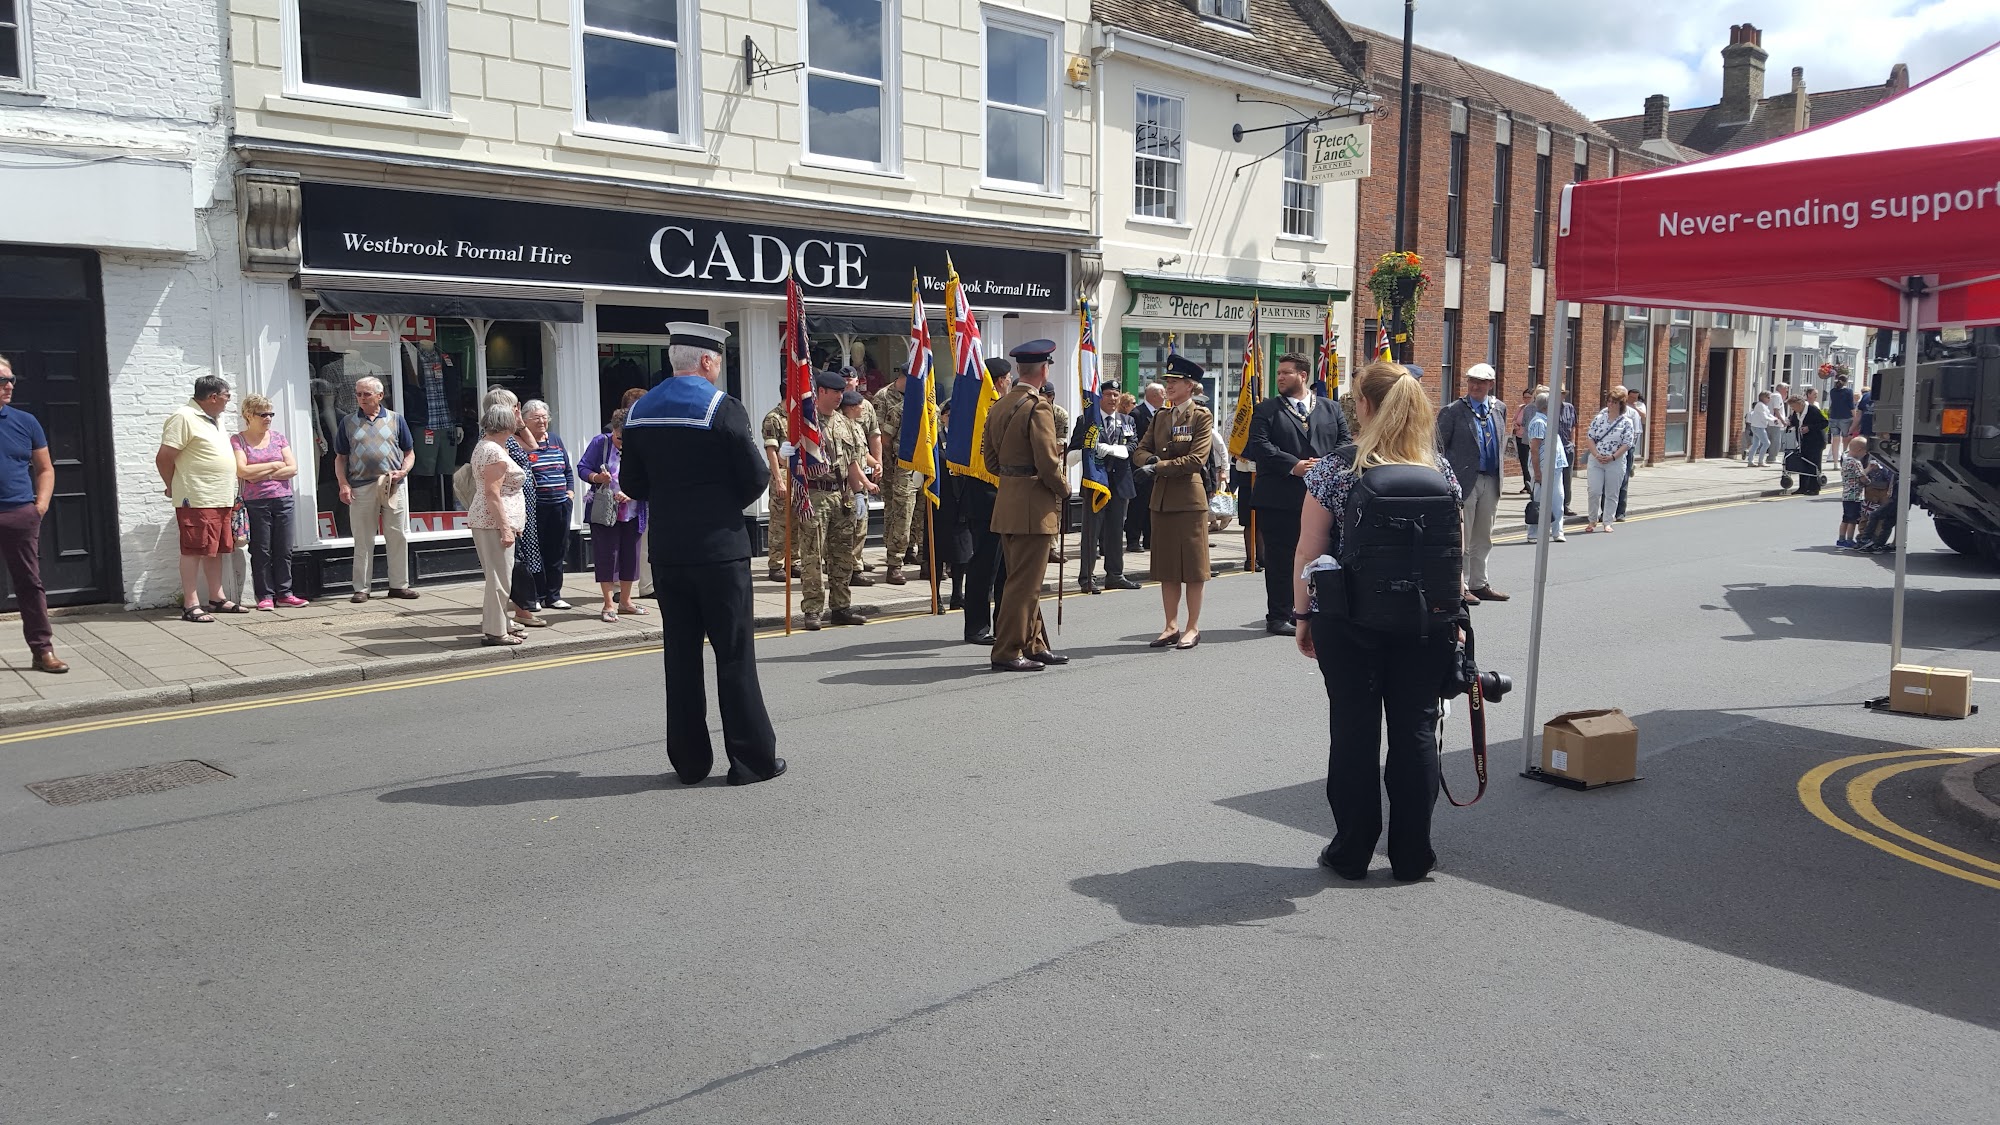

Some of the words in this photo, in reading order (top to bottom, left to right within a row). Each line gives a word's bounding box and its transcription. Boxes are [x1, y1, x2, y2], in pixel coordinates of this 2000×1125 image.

[1313, 133, 1354, 149] Peter
[1315, 149, 1346, 163] Lane
[1343, 136, 1364, 159] &
[1312, 161, 1352, 171] PARTNERS
[1339, 169, 1364, 177] AGENTS
[1659, 198, 1859, 238] Never-ending
[343, 232, 449, 257] Westbrook
[455, 240, 524, 262] Formal
[529, 246, 572, 265] Hire
[650, 226, 869, 289] CADGE
[923, 276, 981, 293] Wesook
[984, 280, 1024, 296] Formal
[1026, 283, 1051, 298] Hire
[1169, 295, 1210, 317] Peter
[1215, 299, 1244, 320] Lane
[1261, 307, 1311, 319] PARTNERS
